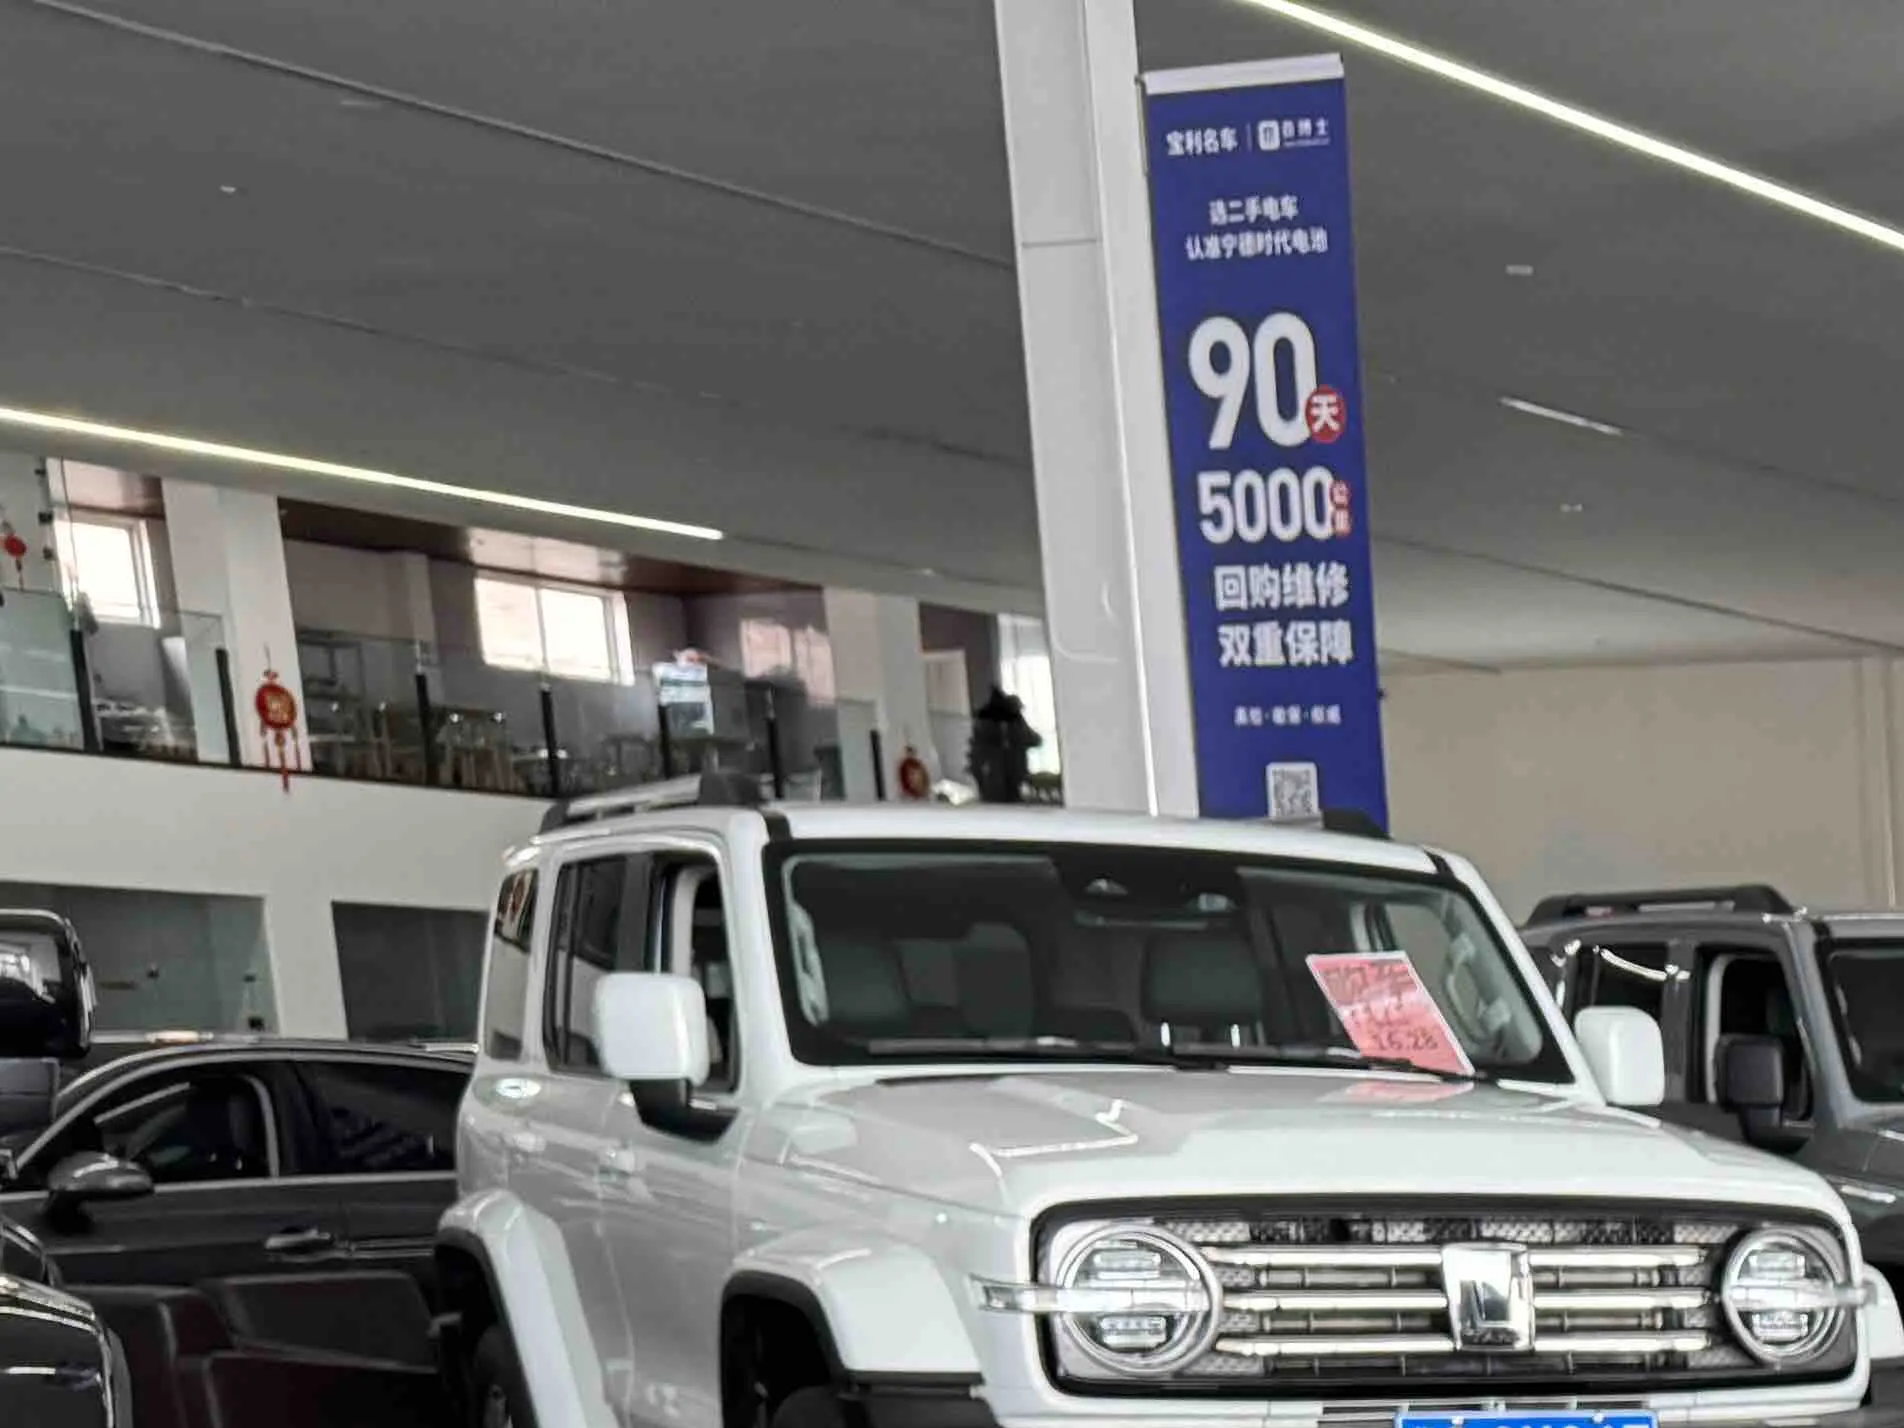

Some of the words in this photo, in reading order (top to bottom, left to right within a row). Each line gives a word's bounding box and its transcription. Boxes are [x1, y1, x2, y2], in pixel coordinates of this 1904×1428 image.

[1165, 127, 1239, 156] 宝利名车
[1188, 311, 1319, 450] 90
[1310, 394, 1342, 433] 天
[1197, 466, 1335, 544] 5000
[1214, 562, 1350, 611] 回购维修
[1218, 619, 1355, 668] 双重保障
